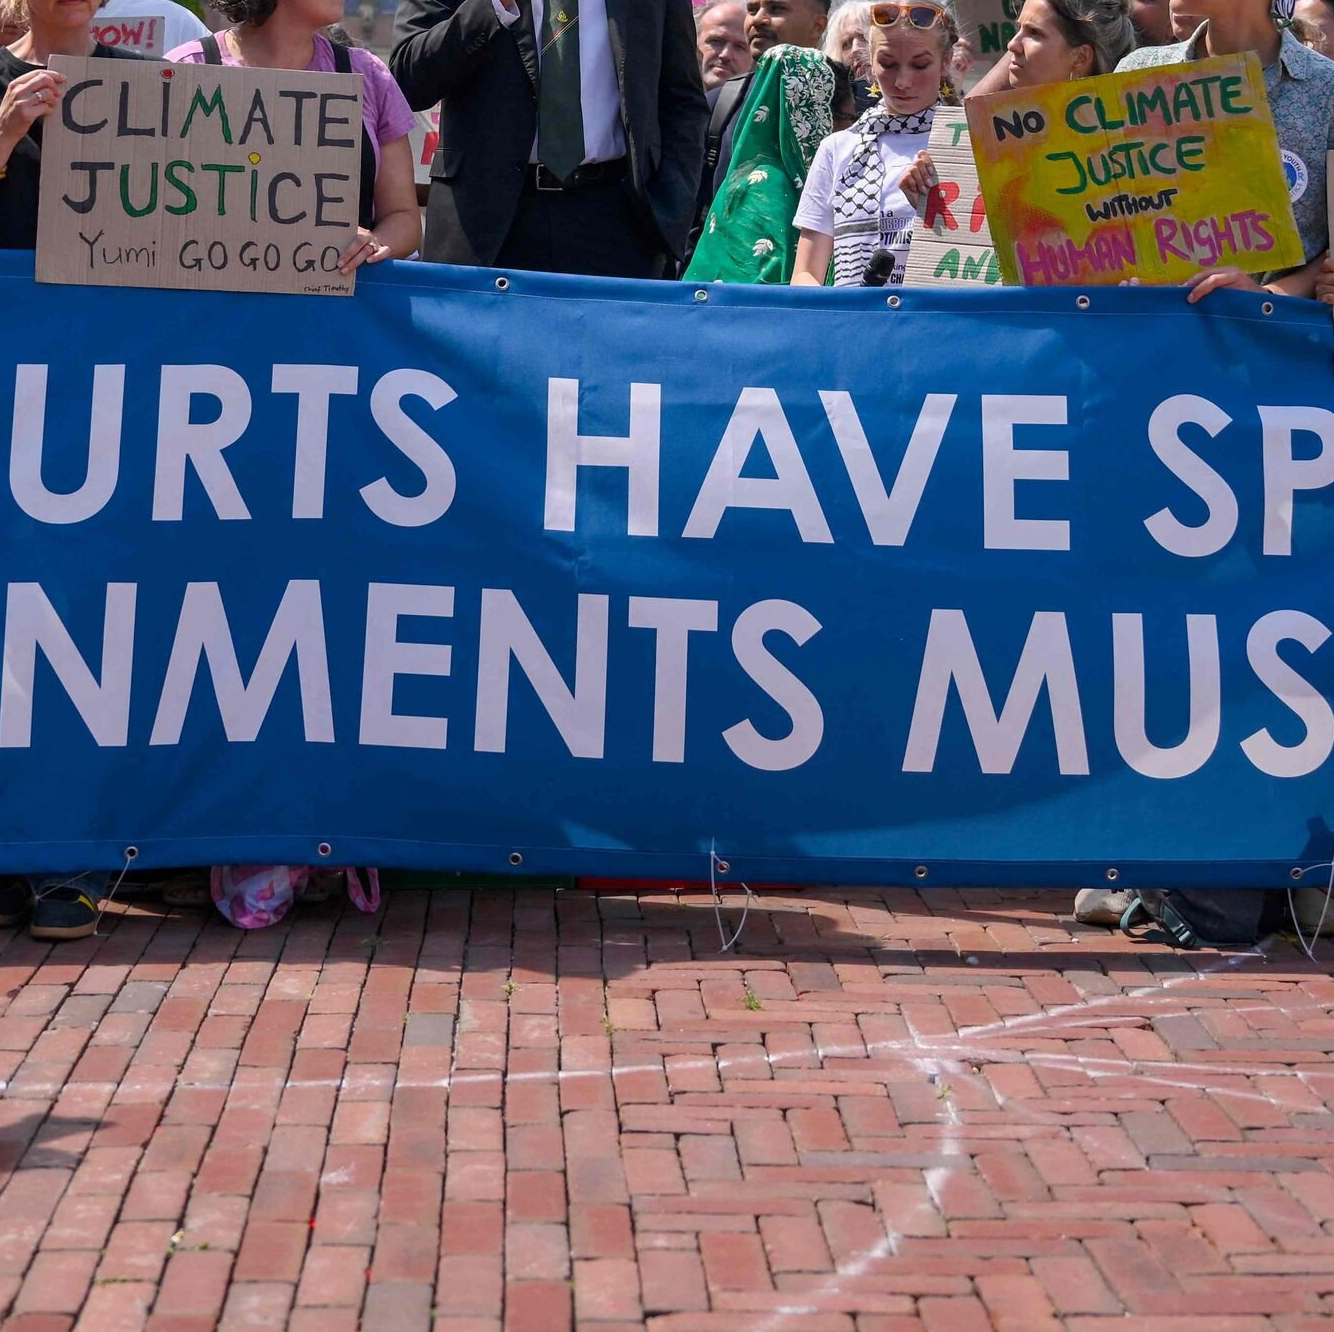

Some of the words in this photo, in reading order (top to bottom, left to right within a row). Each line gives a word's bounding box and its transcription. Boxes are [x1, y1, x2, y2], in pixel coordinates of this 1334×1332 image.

[993, 110, 1045, 141] NO
[1065, 76, 1253, 134] CLIMATE
[1046, 136, 1206, 194] JUSTICE
[1283, 154, 1301, 172] YOUTH
[1086, 189, 1177, 222] WITHOUT
[78, 229, 158, 268] Yumi
[179, 240, 228, 272] GO
[239, 241, 281, 272] GO
[292, 242, 341, 273] GO
[1017, 229, 1137, 286] HUMAN
[1154, 209, 1275, 266] RIGHTS
[544, 378, 1070, 551] HAVE
